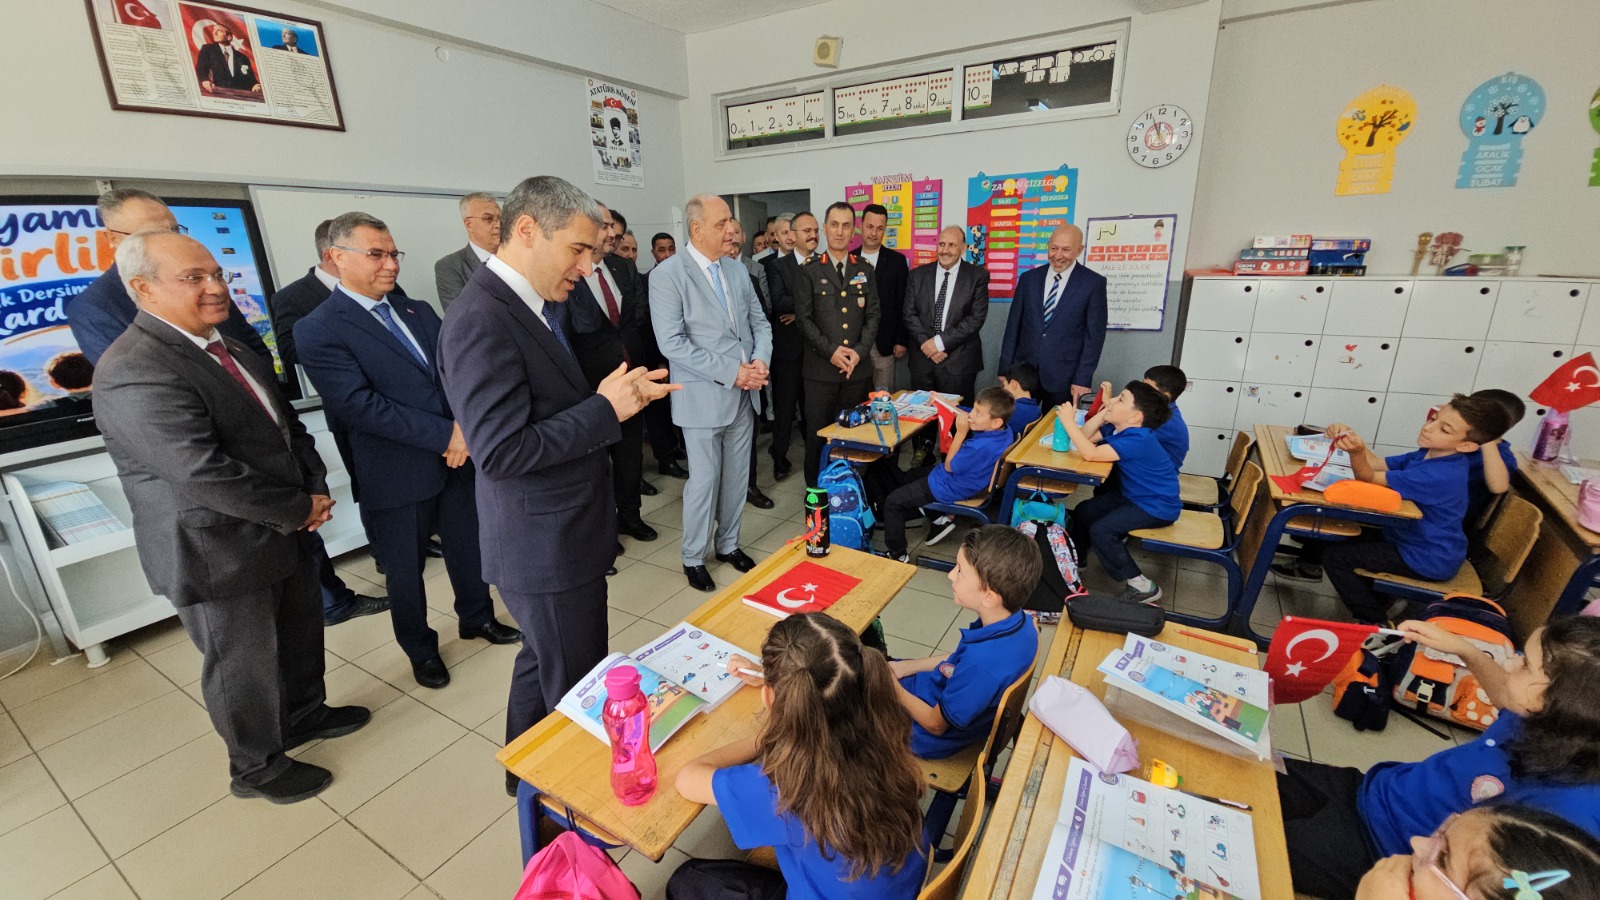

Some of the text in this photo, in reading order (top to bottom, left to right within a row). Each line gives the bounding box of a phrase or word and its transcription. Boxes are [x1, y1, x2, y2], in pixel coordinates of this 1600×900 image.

[967, 86, 980, 101] 10
[905, 96, 912, 110] 8
[929, 93, 937, 106] 9
[859, 103, 866, 116] 6
[882, 100, 889, 113] 7
[1158, 107, 1167, 115] 12
[806, 112, 813, 123] 4
[838, 106, 845, 119] 5
[1145, 112, 1152, 120] 11
[750, 120, 754, 131] 1
[769, 117, 775, 130] 2
[787, 114, 793, 126] 3
[1180, 118, 1187, 126] 2
[730, 123, 737, 134] 0
[1132, 146, 1139, 154] 8
[1475, 151, 1511, 159] ARALIK
[1475, 165, 1504, 173] OCAK
[1471, 179, 1503, 187] ŞUBAT
